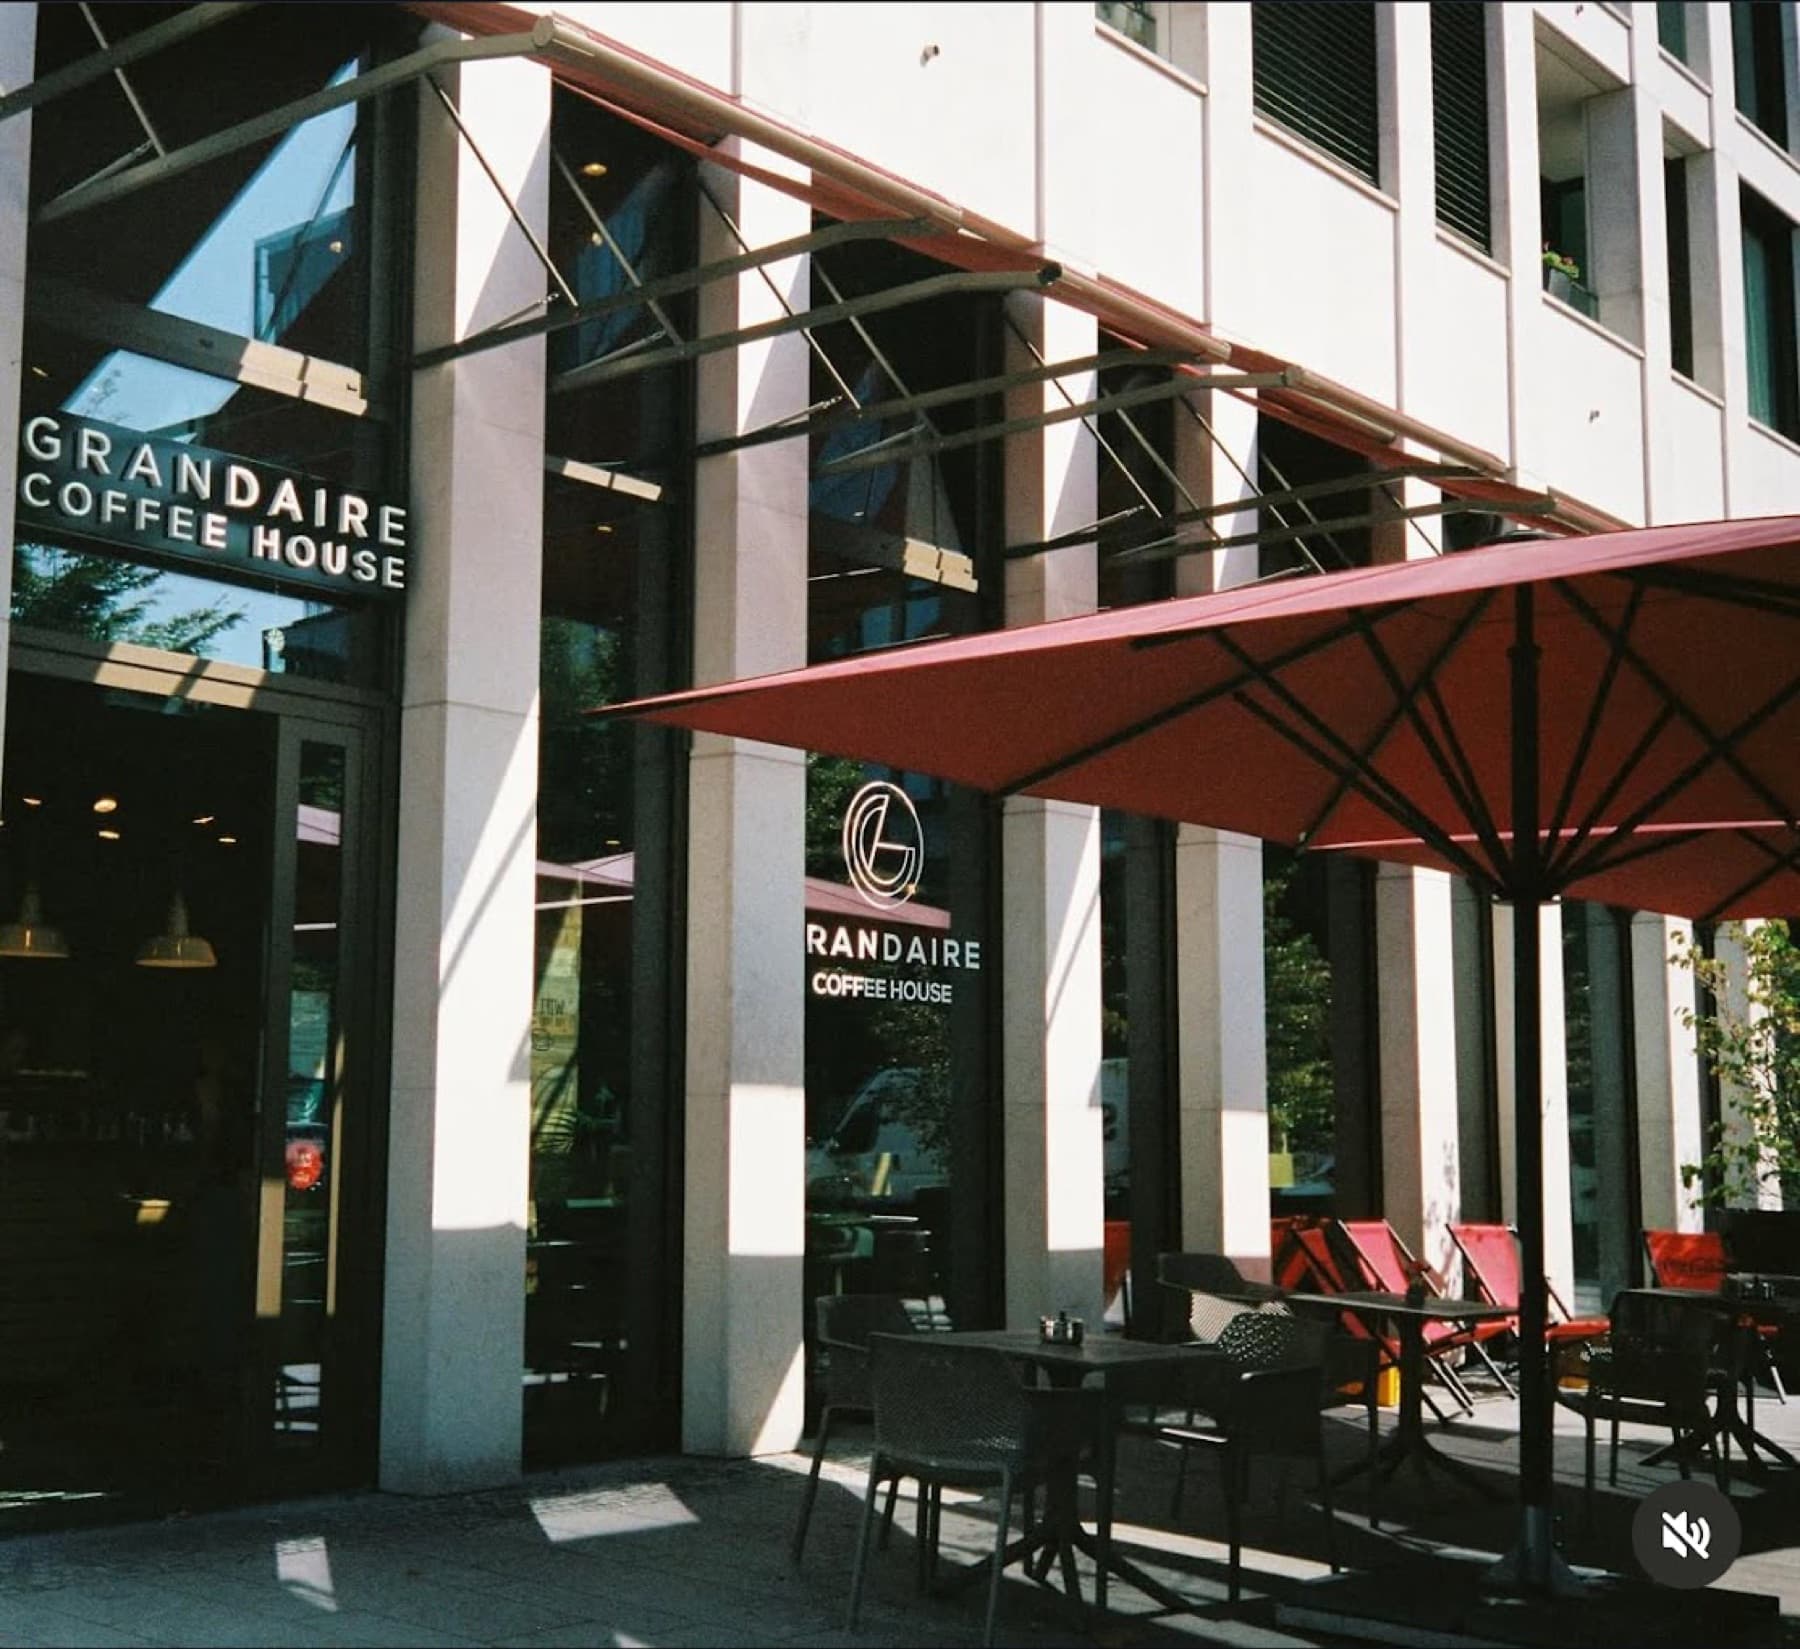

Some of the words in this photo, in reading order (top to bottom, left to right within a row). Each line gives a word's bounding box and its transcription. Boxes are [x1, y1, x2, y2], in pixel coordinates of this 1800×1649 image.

[25, 416, 406, 546] GRANDAIRE
[21, 473, 228, 548] COFFEE
[253, 525, 405, 588] HOUSE
[806, 923, 981, 969] RANDAIRE
[812, 972, 887, 998] COFFEE
[890, 980, 952, 1003] HOUSE
